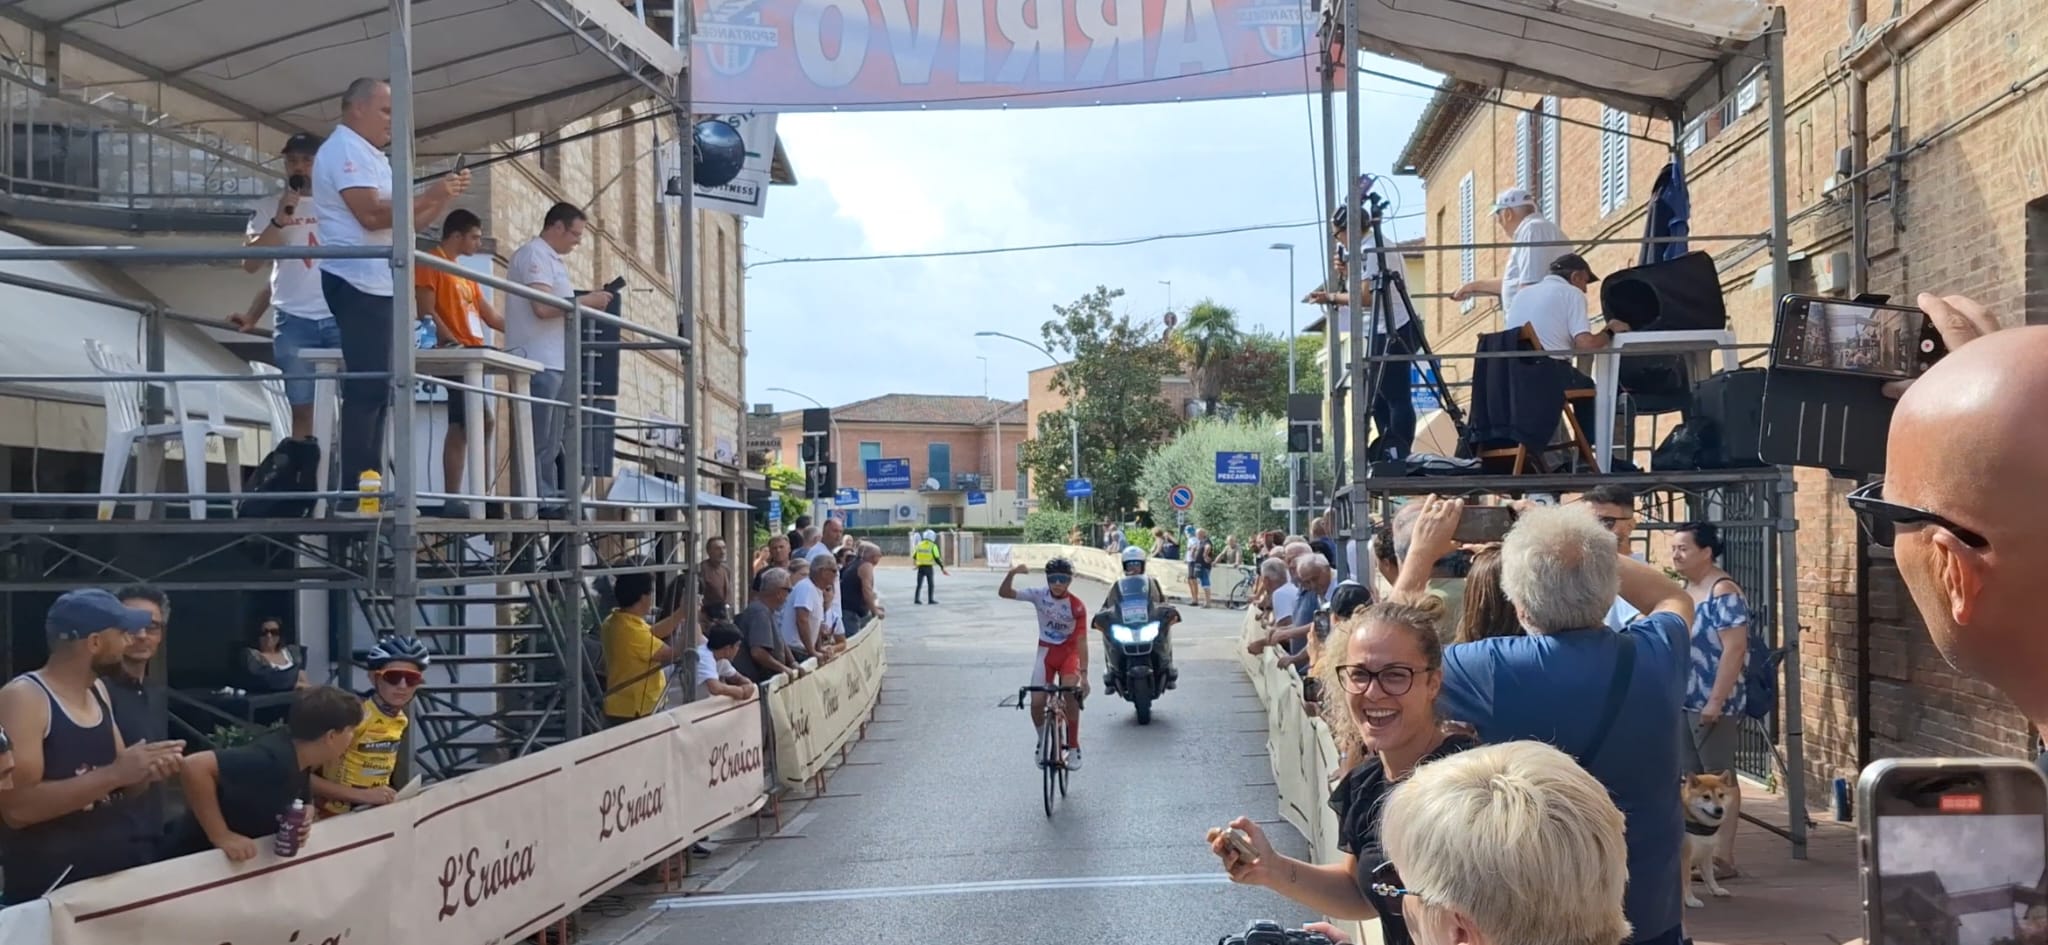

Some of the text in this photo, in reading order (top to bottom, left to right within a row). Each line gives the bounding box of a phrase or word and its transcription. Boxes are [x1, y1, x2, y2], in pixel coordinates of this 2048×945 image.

[709, 740, 762, 789] L'Eroica
[599, 781, 663, 843] L'Eroica
[438, 839, 535, 922] L'Eroica
